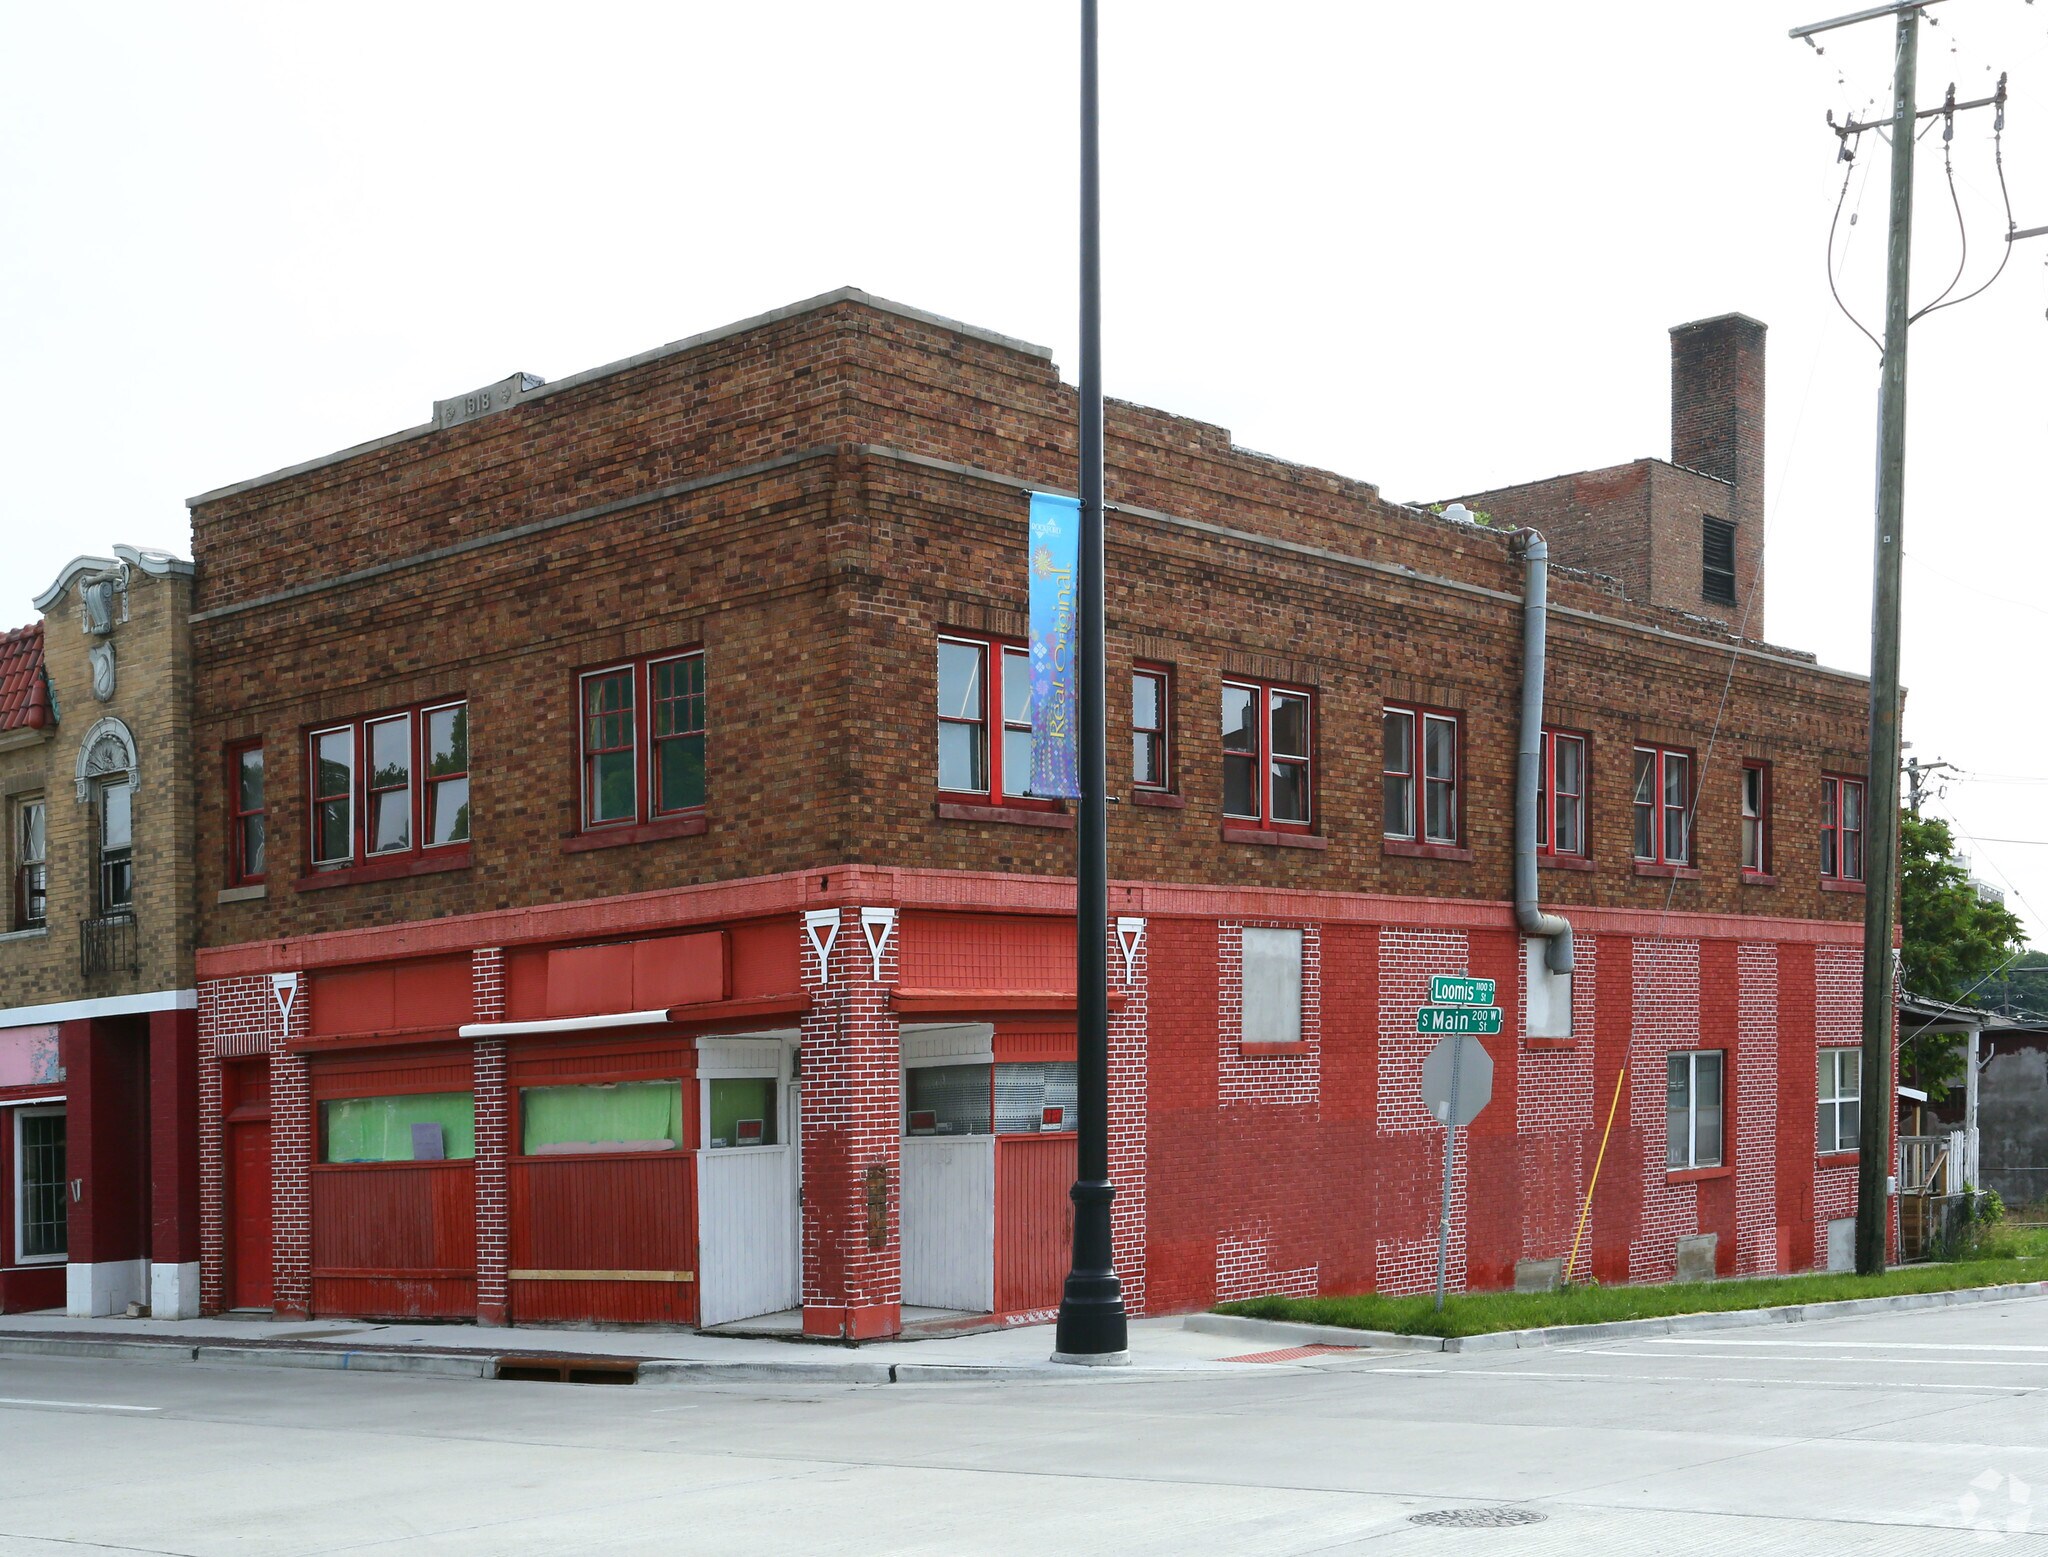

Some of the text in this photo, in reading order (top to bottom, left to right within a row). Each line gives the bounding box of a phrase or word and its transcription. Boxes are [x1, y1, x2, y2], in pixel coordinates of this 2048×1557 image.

[464, 392, 490, 416] 1918
[1050, 563, 1071, 738] Real. Original.
[1435, 979, 1493, 1001] Loomis 1100 S
[1480, 993, 1487, 1002] St
[1422, 1010, 1497, 1030] S Main 200 W
[1478, 1022, 1487, 1032] St
